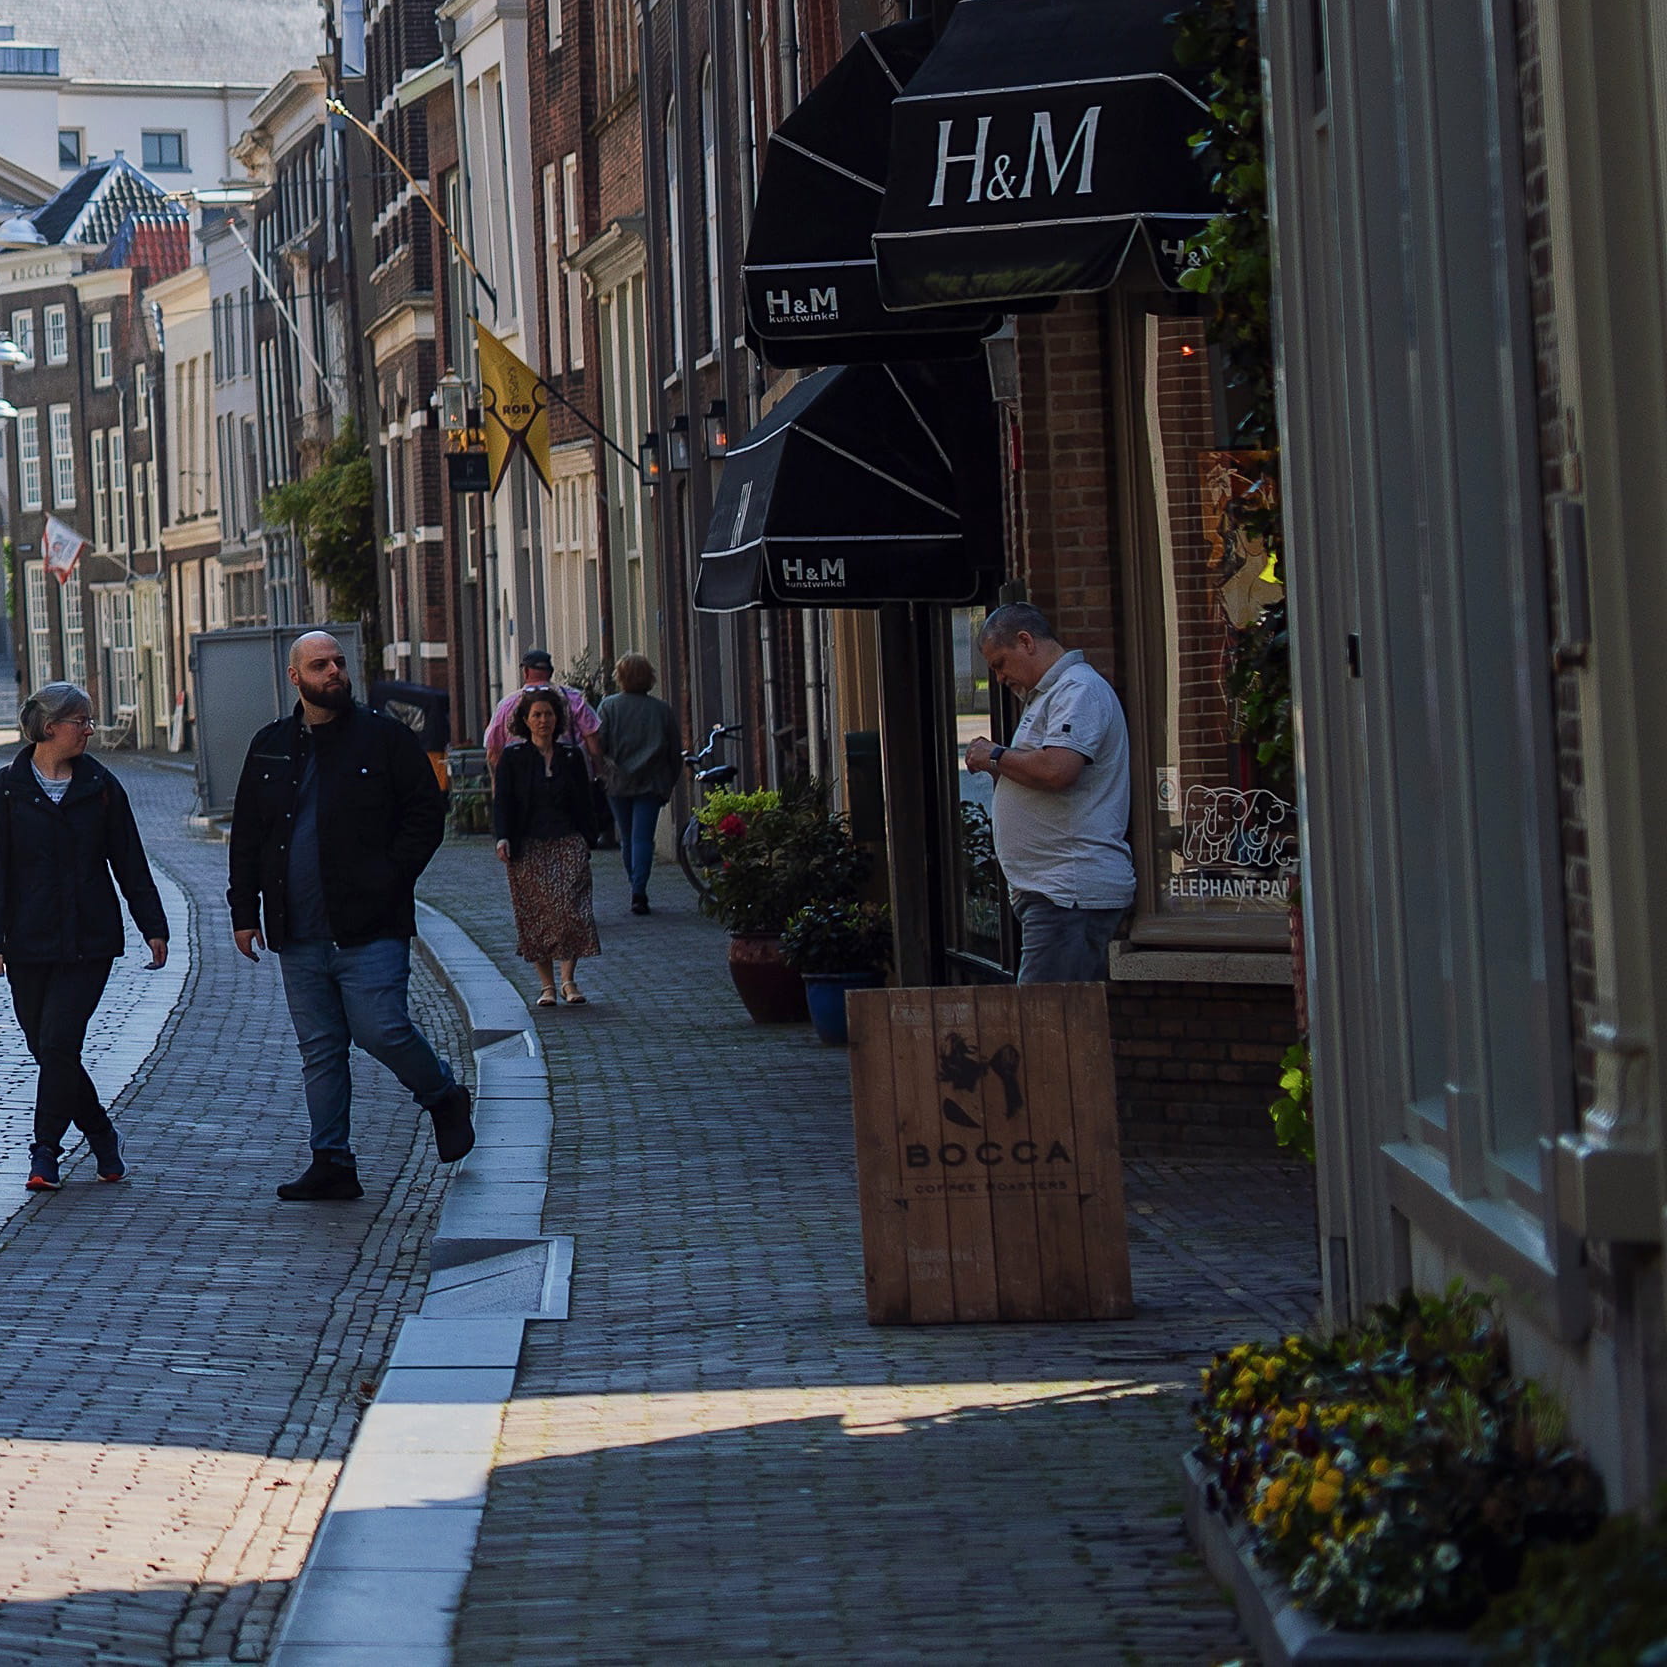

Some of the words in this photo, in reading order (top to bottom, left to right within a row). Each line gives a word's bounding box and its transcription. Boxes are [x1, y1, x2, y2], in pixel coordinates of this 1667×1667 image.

[928, 105, 1102, 207] H&M
[1161, 239, 1212, 266] H&
[766, 286, 838, 315] H&M
[769, 311, 839, 324] kunstwinkel
[502, 404, 531, 415] ROB
[782, 558, 845, 581] H&M
[1169, 878, 1256, 897] ELEPHANT
[906, 1140, 1071, 1168] BOCCA
